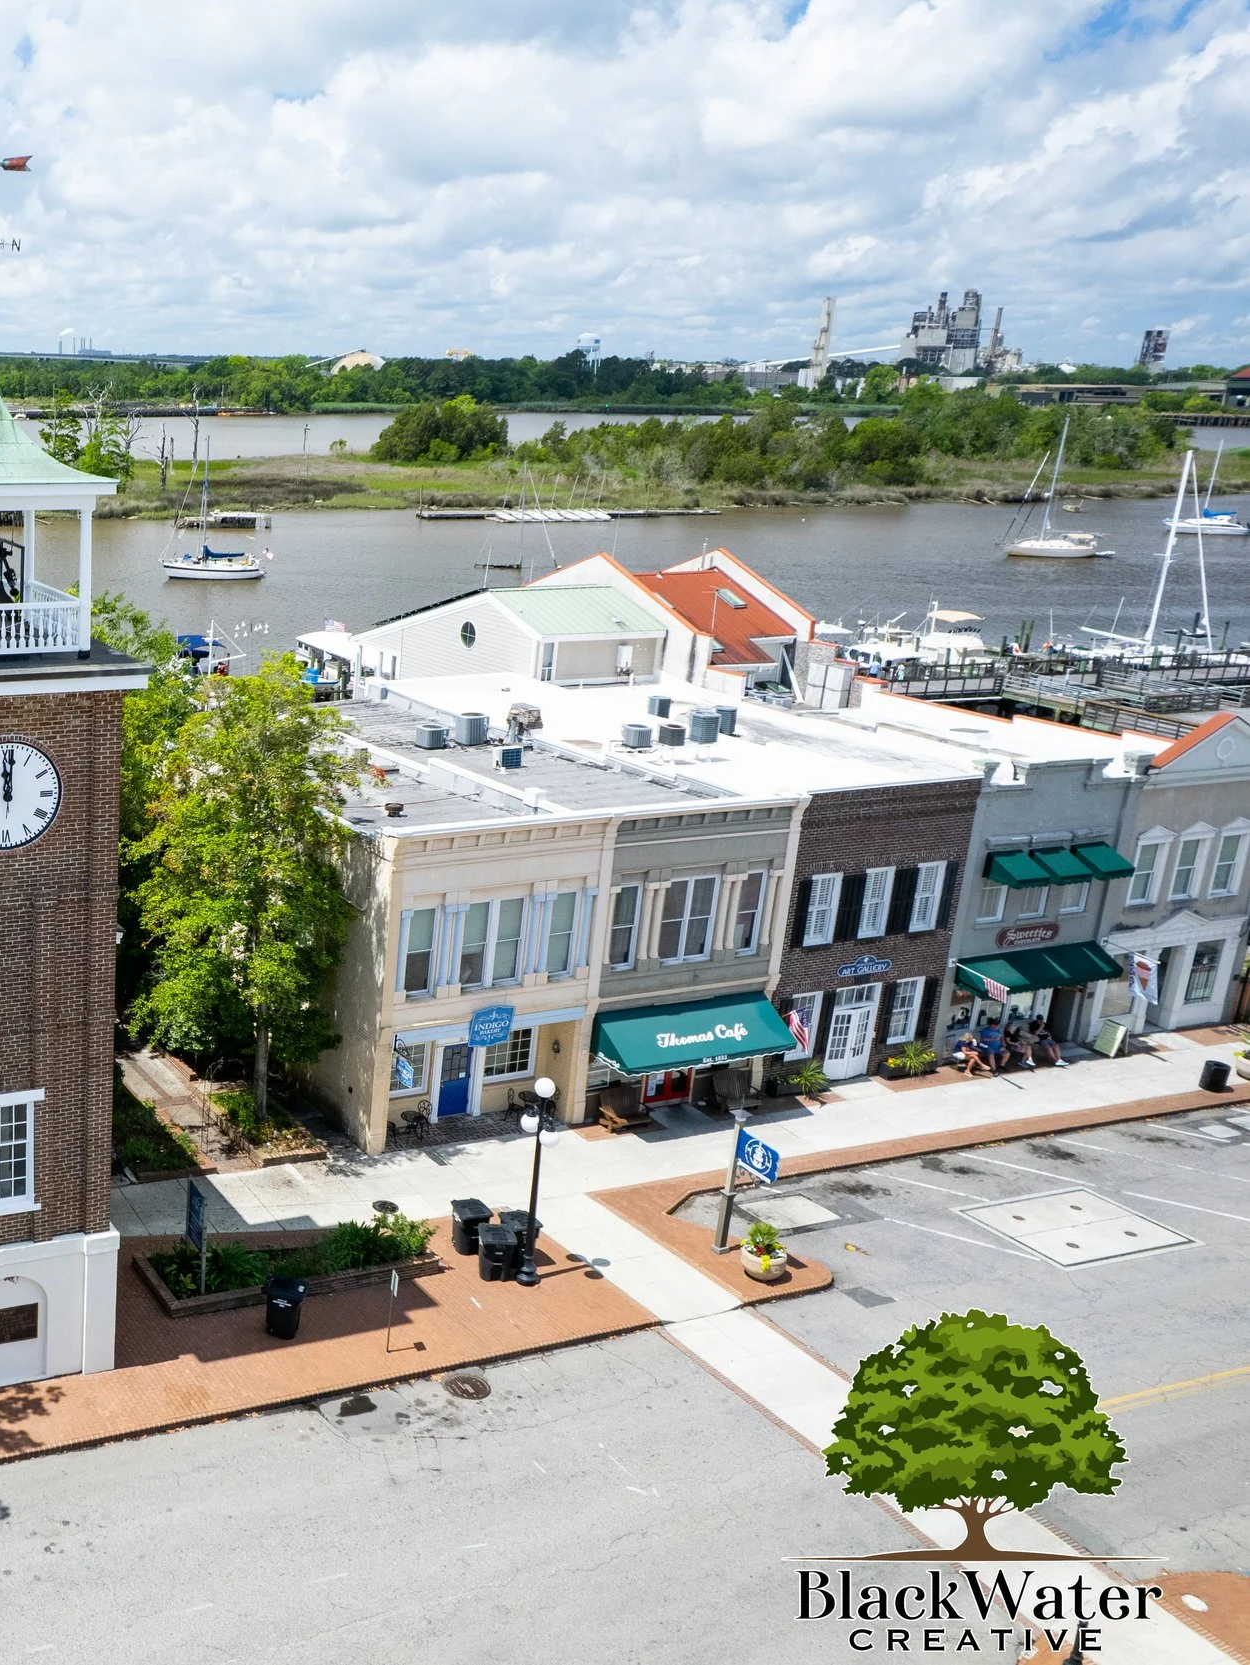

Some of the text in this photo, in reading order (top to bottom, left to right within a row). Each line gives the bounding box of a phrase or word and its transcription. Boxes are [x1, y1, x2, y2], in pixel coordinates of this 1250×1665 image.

[35, 769, 48, 780] II
[1003, 928, 1054, 947] Sweeties
[841, 967, 855, 976] ART
[857, 963, 888, 974] GALLERY
[474, 1020, 509, 1031] INDIGO
[480, 1028, 501, 1036] BAKERY
[657, 1022, 748, 1048] Thomas Café
[702, 1056, 713, 1064] Est.
